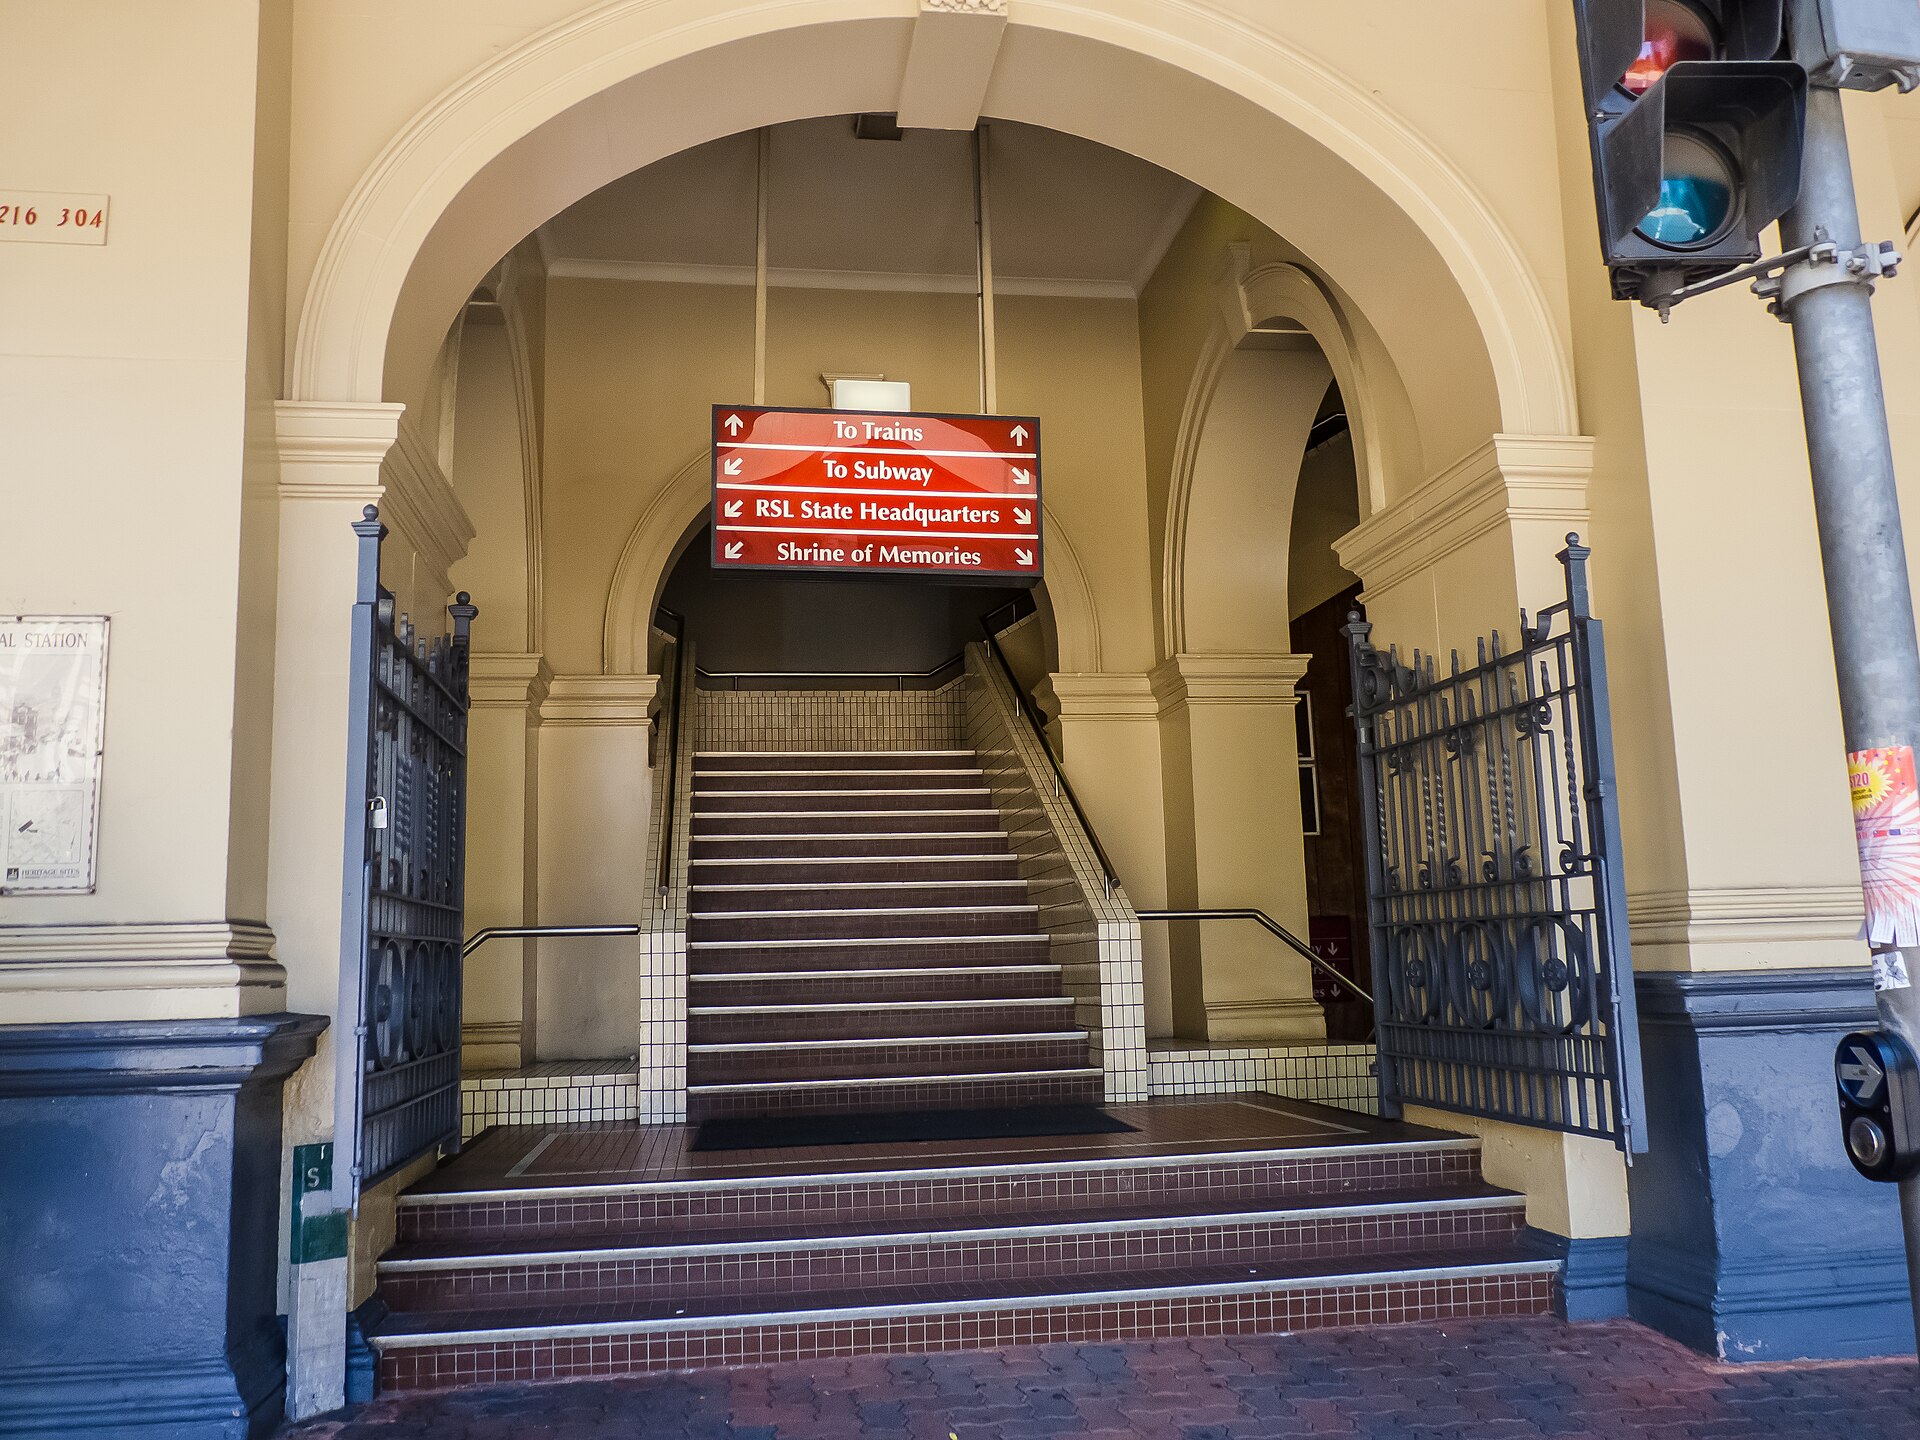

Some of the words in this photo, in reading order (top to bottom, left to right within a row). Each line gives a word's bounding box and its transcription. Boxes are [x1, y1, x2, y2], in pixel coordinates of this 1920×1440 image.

[0, 205, 36, 226] 216
[57, 208, 103, 228] 304
[832, 420, 858, 440] To
[864, 421, 924, 442] Trains
[823, 459, 848, 480] To
[853, 460, 934, 487] Subway
[756, 499, 795, 518] RSL
[800, 500, 853, 520] State
[859, 502, 1000, 528] Headquarters
[777, 542, 845, 563] Shrine
[851, 543, 874, 563] of
[878, 545, 982, 566] Memories
[24, 632, 89, 648] STATION
